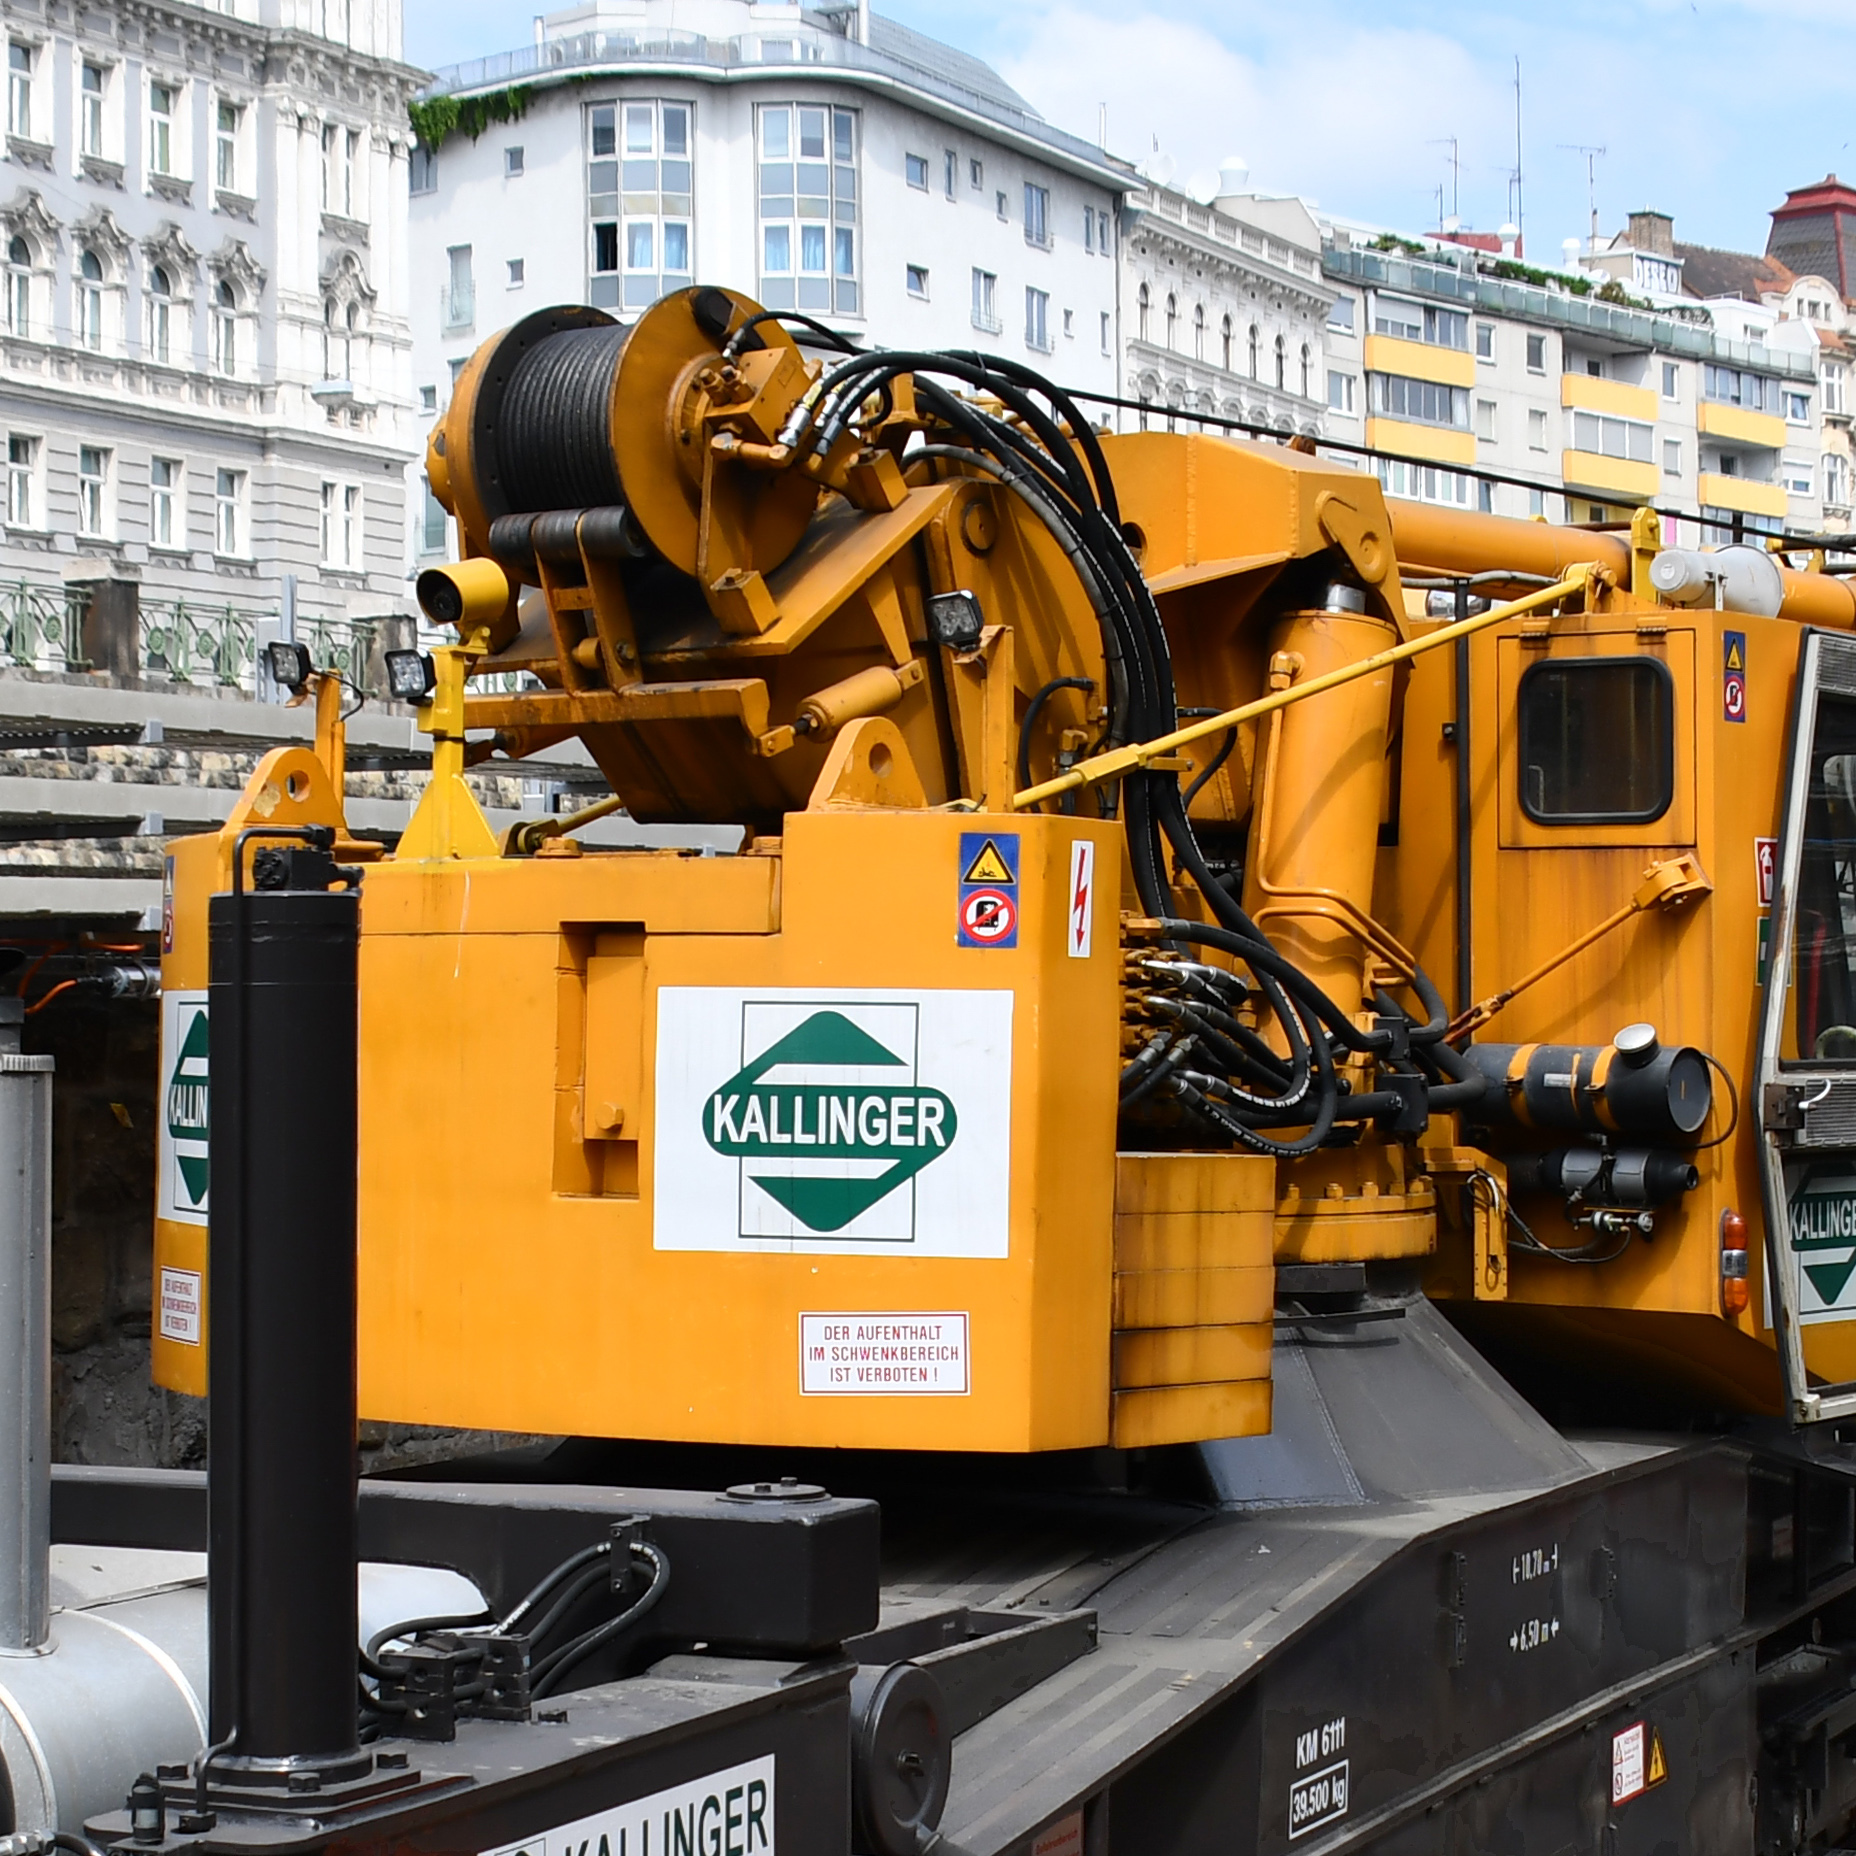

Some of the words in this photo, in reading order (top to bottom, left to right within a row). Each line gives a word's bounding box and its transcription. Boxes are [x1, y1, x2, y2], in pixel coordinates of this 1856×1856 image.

[168, 1084, 208, 1128] KALLIN
[713, 1094, 946, 1148] KALLINGER
[824, 1325, 850, 1340] DER
[857, 1325, 942, 1340] AUFENTHALT
[809, 1346, 825, 1361] IM
[831, 1346, 959, 1361] SCHWENKBEREICH
[830, 1367, 851, 1382] IST
[857, 1367, 928, 1382] VERBOTEN
[1521, 1547, 1542, 1582] 10,70
[1520, 1618, 1540, 1652] 6,50
[1296, 1728, 1318, 1769] KM
[1321, 1715, 1346, 1756] 6111
[1293, 1779, 1330, 1823] 39.500
[1332, 1774, 1346, 1809] kg
